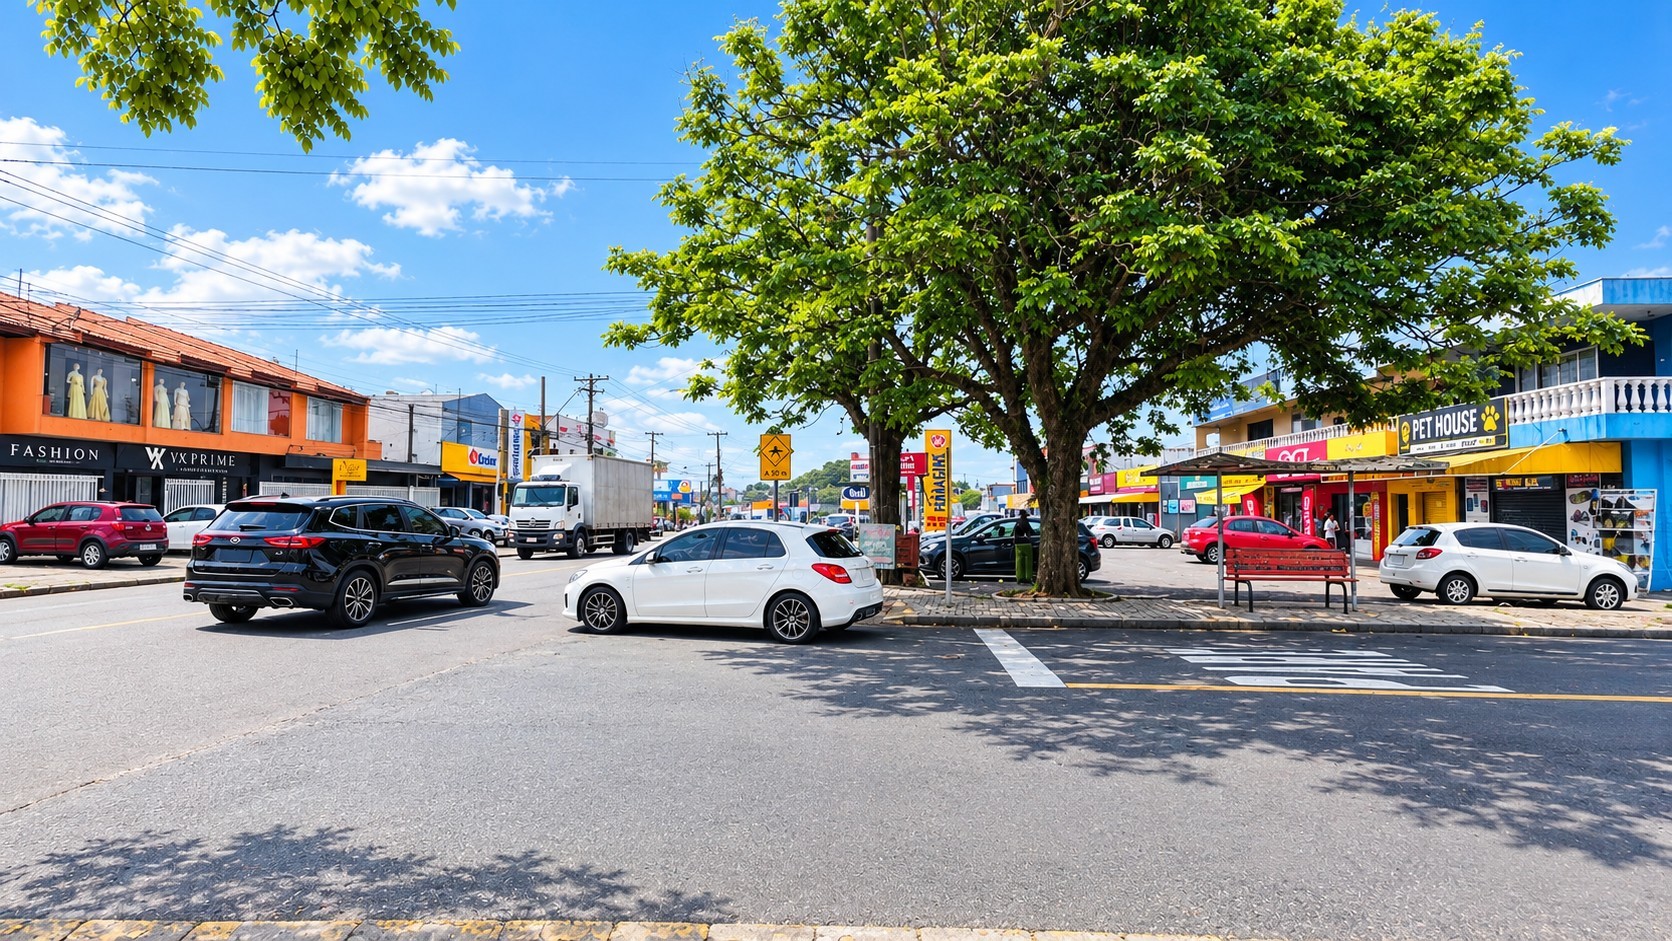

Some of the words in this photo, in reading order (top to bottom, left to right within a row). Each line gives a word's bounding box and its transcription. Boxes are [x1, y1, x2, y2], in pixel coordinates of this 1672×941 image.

[1413, 416, 1432, 440] PET
[1435, 408, 1478, 437] HOUSE
[10, 443, 99, 461] FASHION
